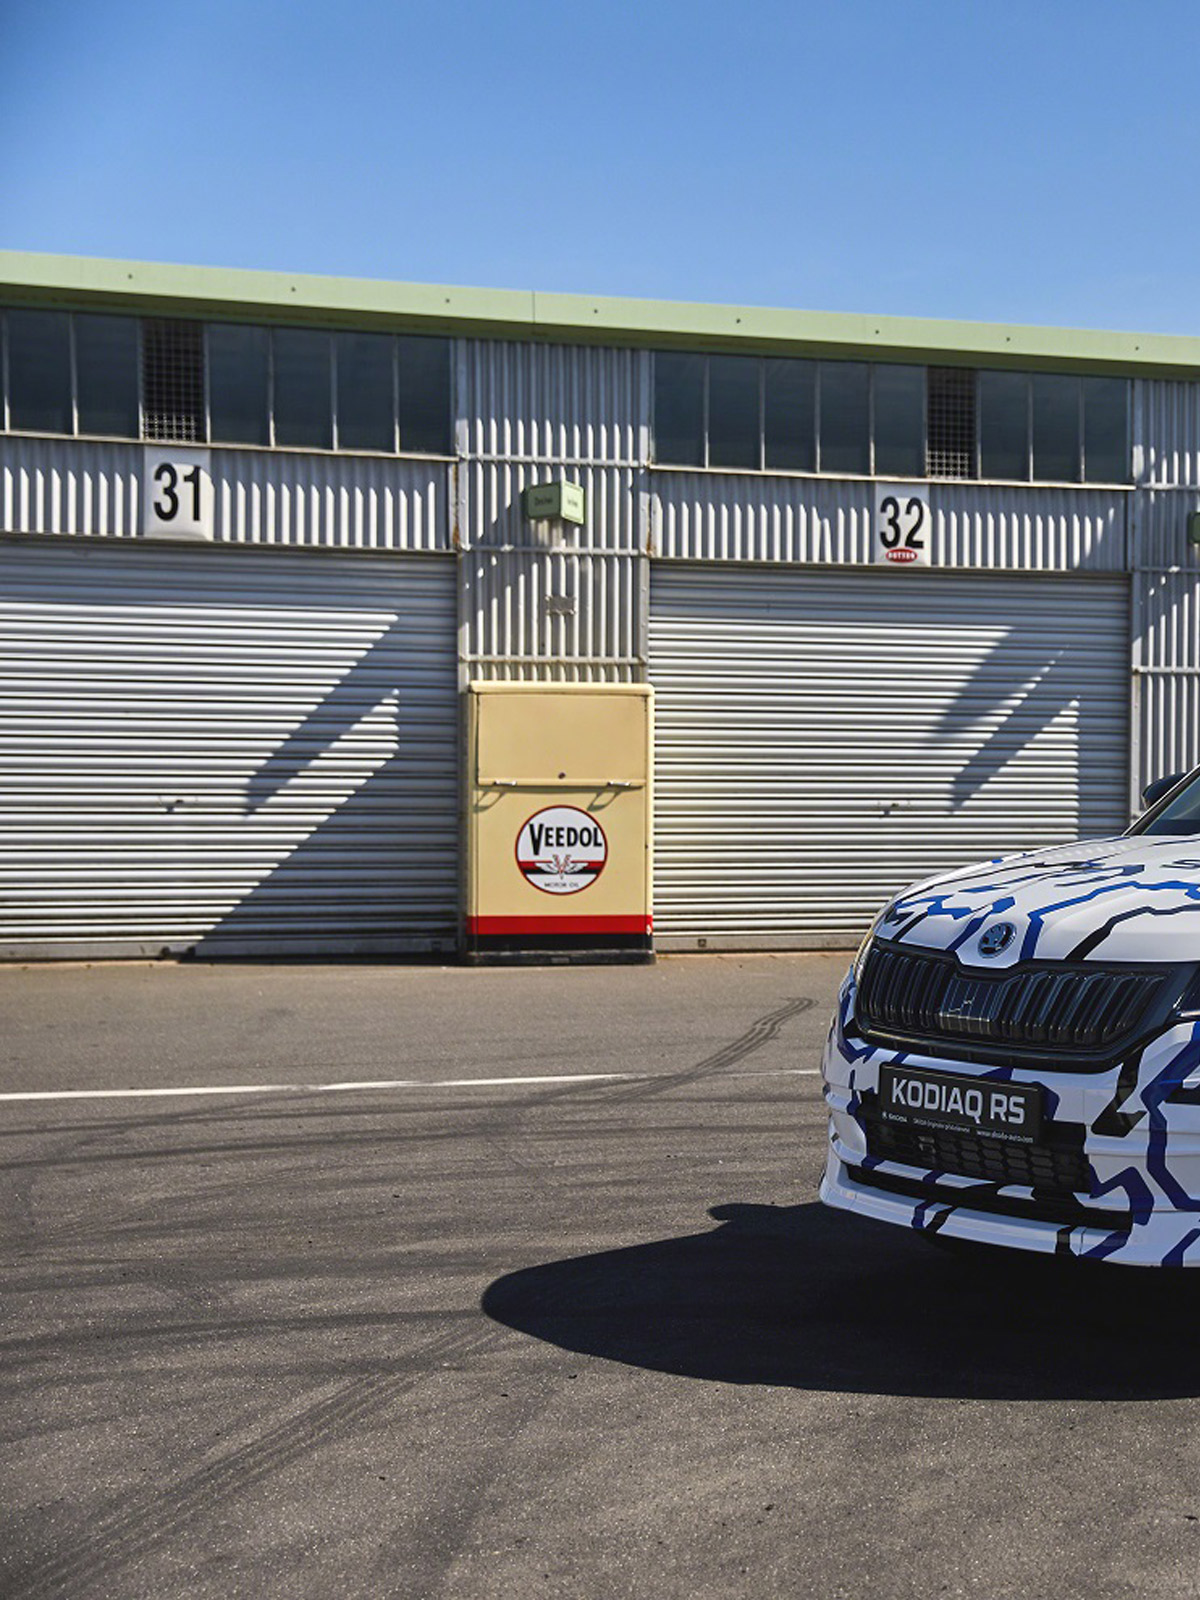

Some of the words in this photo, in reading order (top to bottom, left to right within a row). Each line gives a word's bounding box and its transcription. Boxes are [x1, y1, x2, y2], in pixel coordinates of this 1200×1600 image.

[153, 462, 202, 522] 31
[879, 495, 925, 550] 32
[528, 822, 603, 856] VEEDOL
[891, 1076, 983, 1125] KODIAQ
[989, 1091, 1027, 1126] RS
